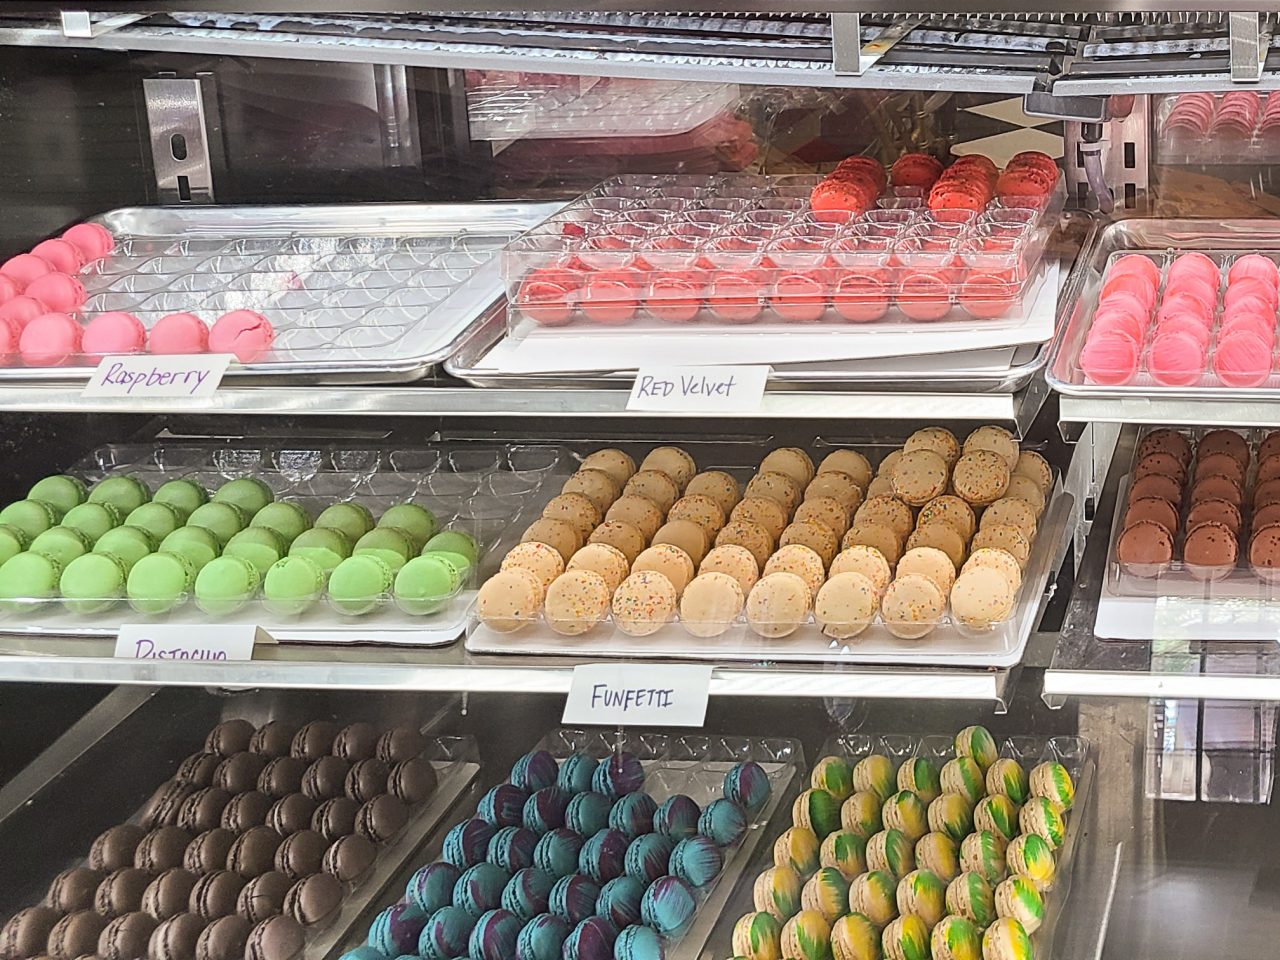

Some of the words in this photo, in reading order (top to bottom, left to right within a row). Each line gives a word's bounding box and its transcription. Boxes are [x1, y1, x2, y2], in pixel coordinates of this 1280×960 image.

[101, 363, 210, 394] Raspberry
[637, 376, 674, 398] RED
[681, 375, 736, 397] Velvet
[592, 684, 673, 711] FUNFETTI
